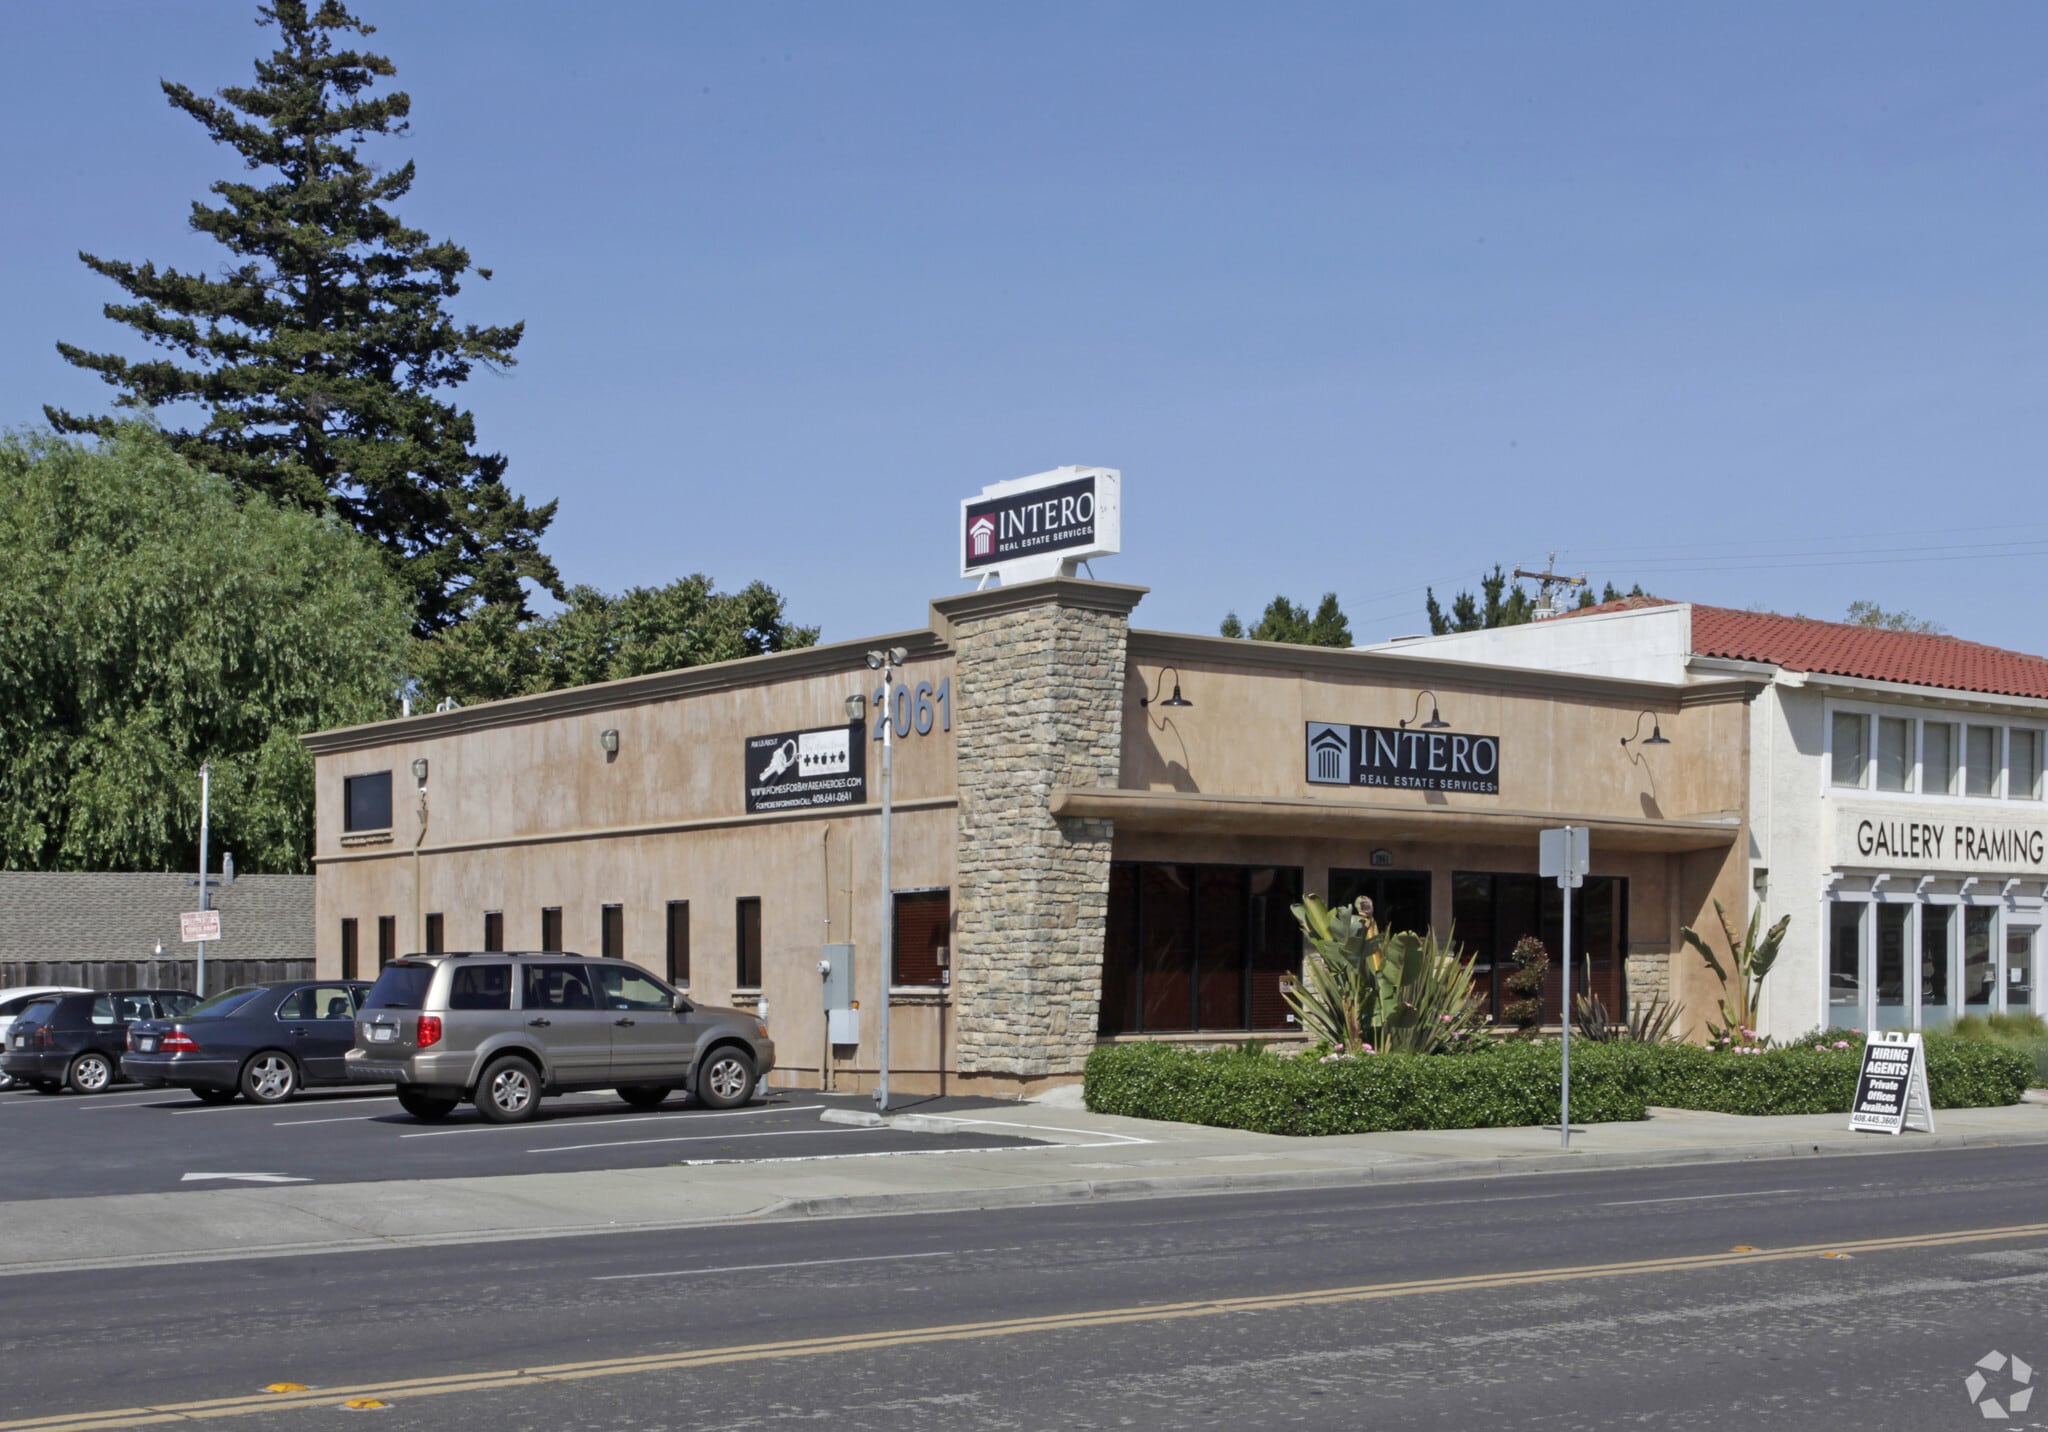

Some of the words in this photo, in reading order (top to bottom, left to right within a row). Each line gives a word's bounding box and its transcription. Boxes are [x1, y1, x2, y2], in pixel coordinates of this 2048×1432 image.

[1000, 492, 1095, 540] INTERO
[1000, 542, 1019, 552] REAL
[1021, 535, 1050, 547] ESTATE
[1053, 526, 1093, 541] SERVICES
[873, 676, 950, 740] 2061
[1359, 728, 1497, 775] INTERO
[1360, 774, 1389, 786] REAL
[1394, 776, 1435, 789] ESTATE
[1440, 779, 1493, 792] SERVICES
[1857, 819, 1944, 860] GALLERY
[1955, 826, 2044, 865] FRAMING
[1872, 1047, 1909, 1061] HIRING
[1865, 1061, 1909, 1076] AGENTS
[1869, 1079, 1898, 1090] Private
[1867, 1091, 1896, 1102] Offices
[1860, 1101, 1898, 1114] Available
